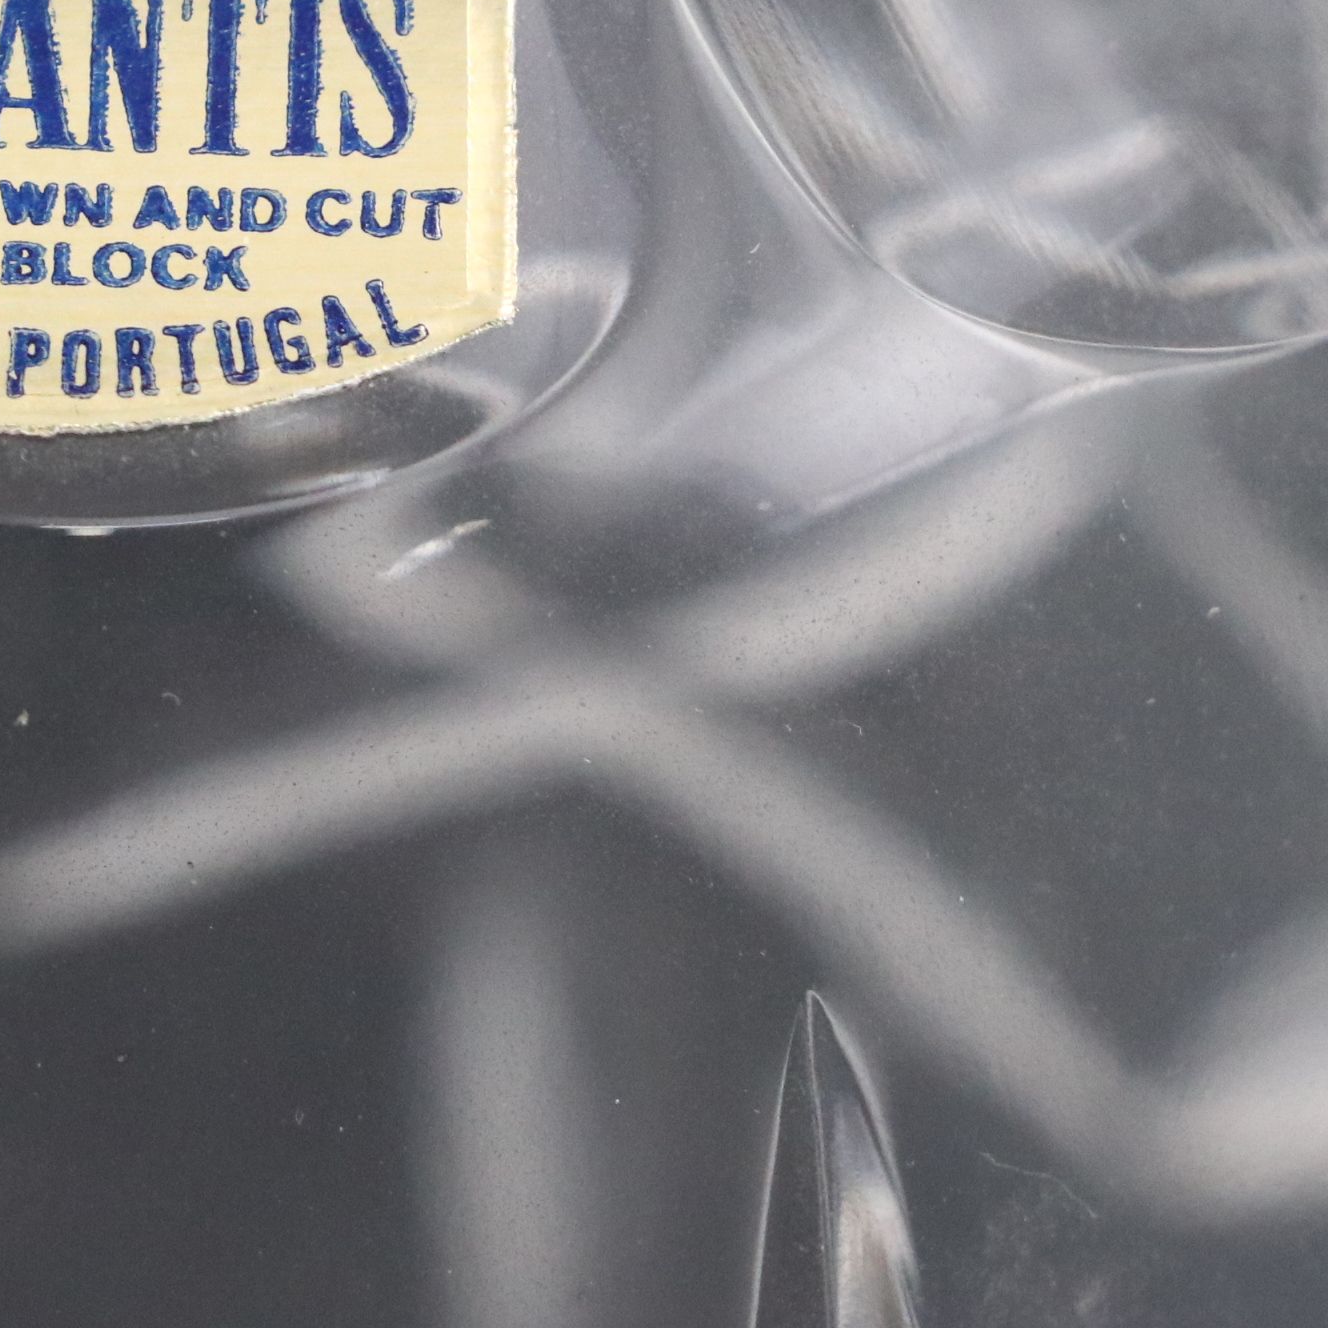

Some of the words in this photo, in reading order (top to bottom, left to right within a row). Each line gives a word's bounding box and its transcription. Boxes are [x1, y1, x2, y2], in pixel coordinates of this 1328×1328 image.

[133, 185, 287, 234] AND
[304, 188, 464, 241] CUT
[0, 239, 251, 292] BLOCK
[4, 279, 430, 400] PORTUGAL
